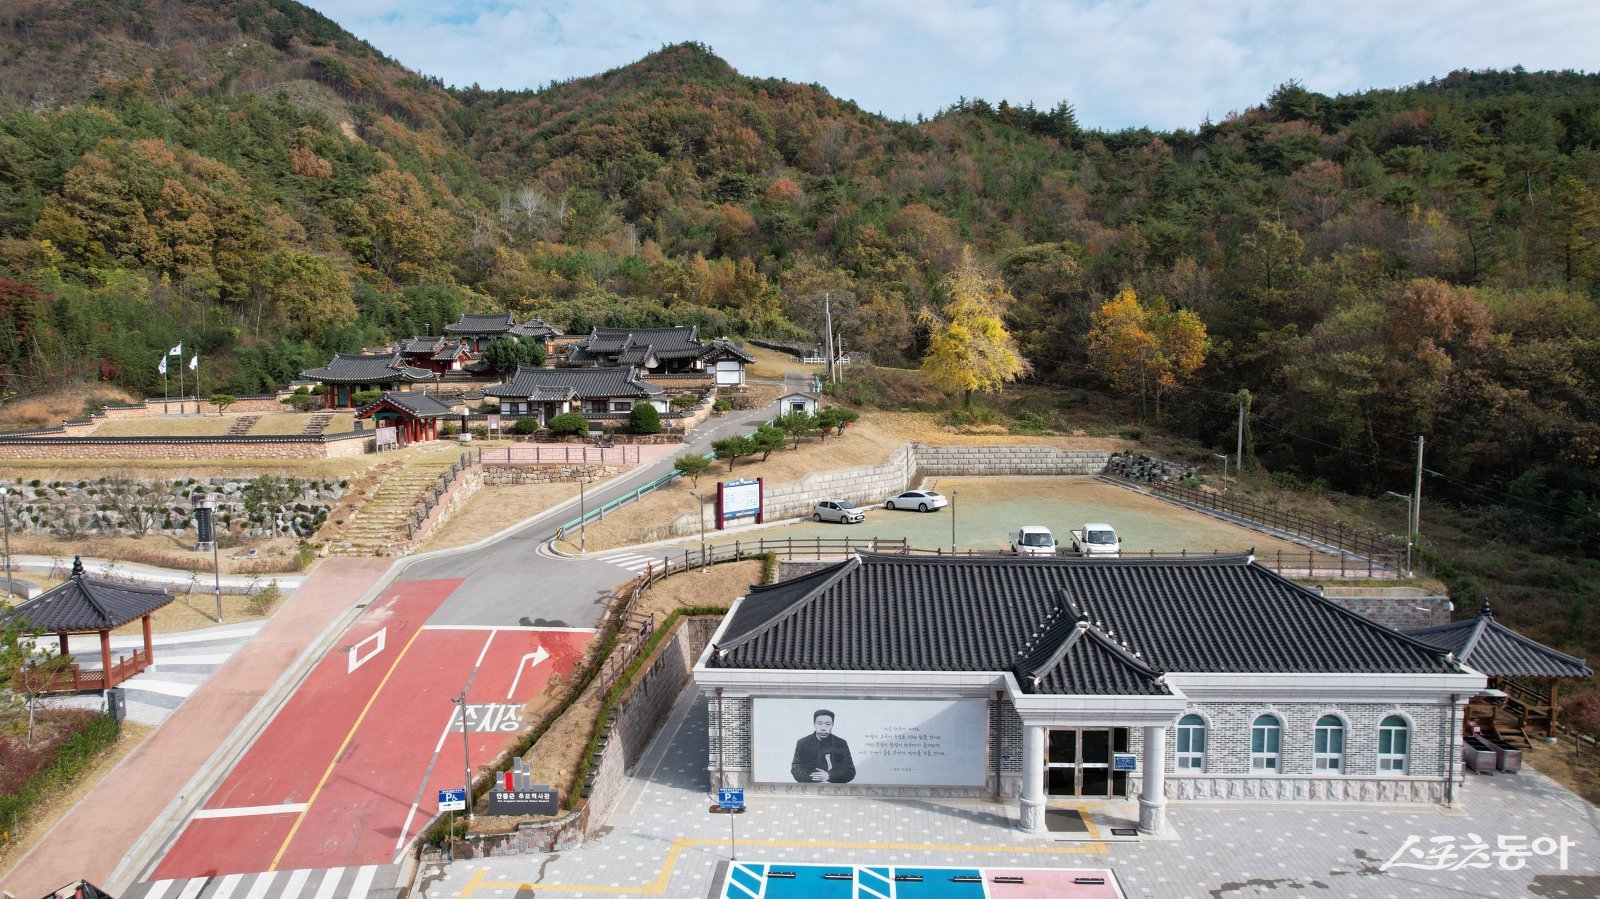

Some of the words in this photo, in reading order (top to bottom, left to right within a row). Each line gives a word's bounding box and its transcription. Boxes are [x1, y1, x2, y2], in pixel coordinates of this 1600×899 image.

[455, 703, 527, 732] 주차장
[446, 793, 452, 802] P
[725, 793, 731, 801] P
